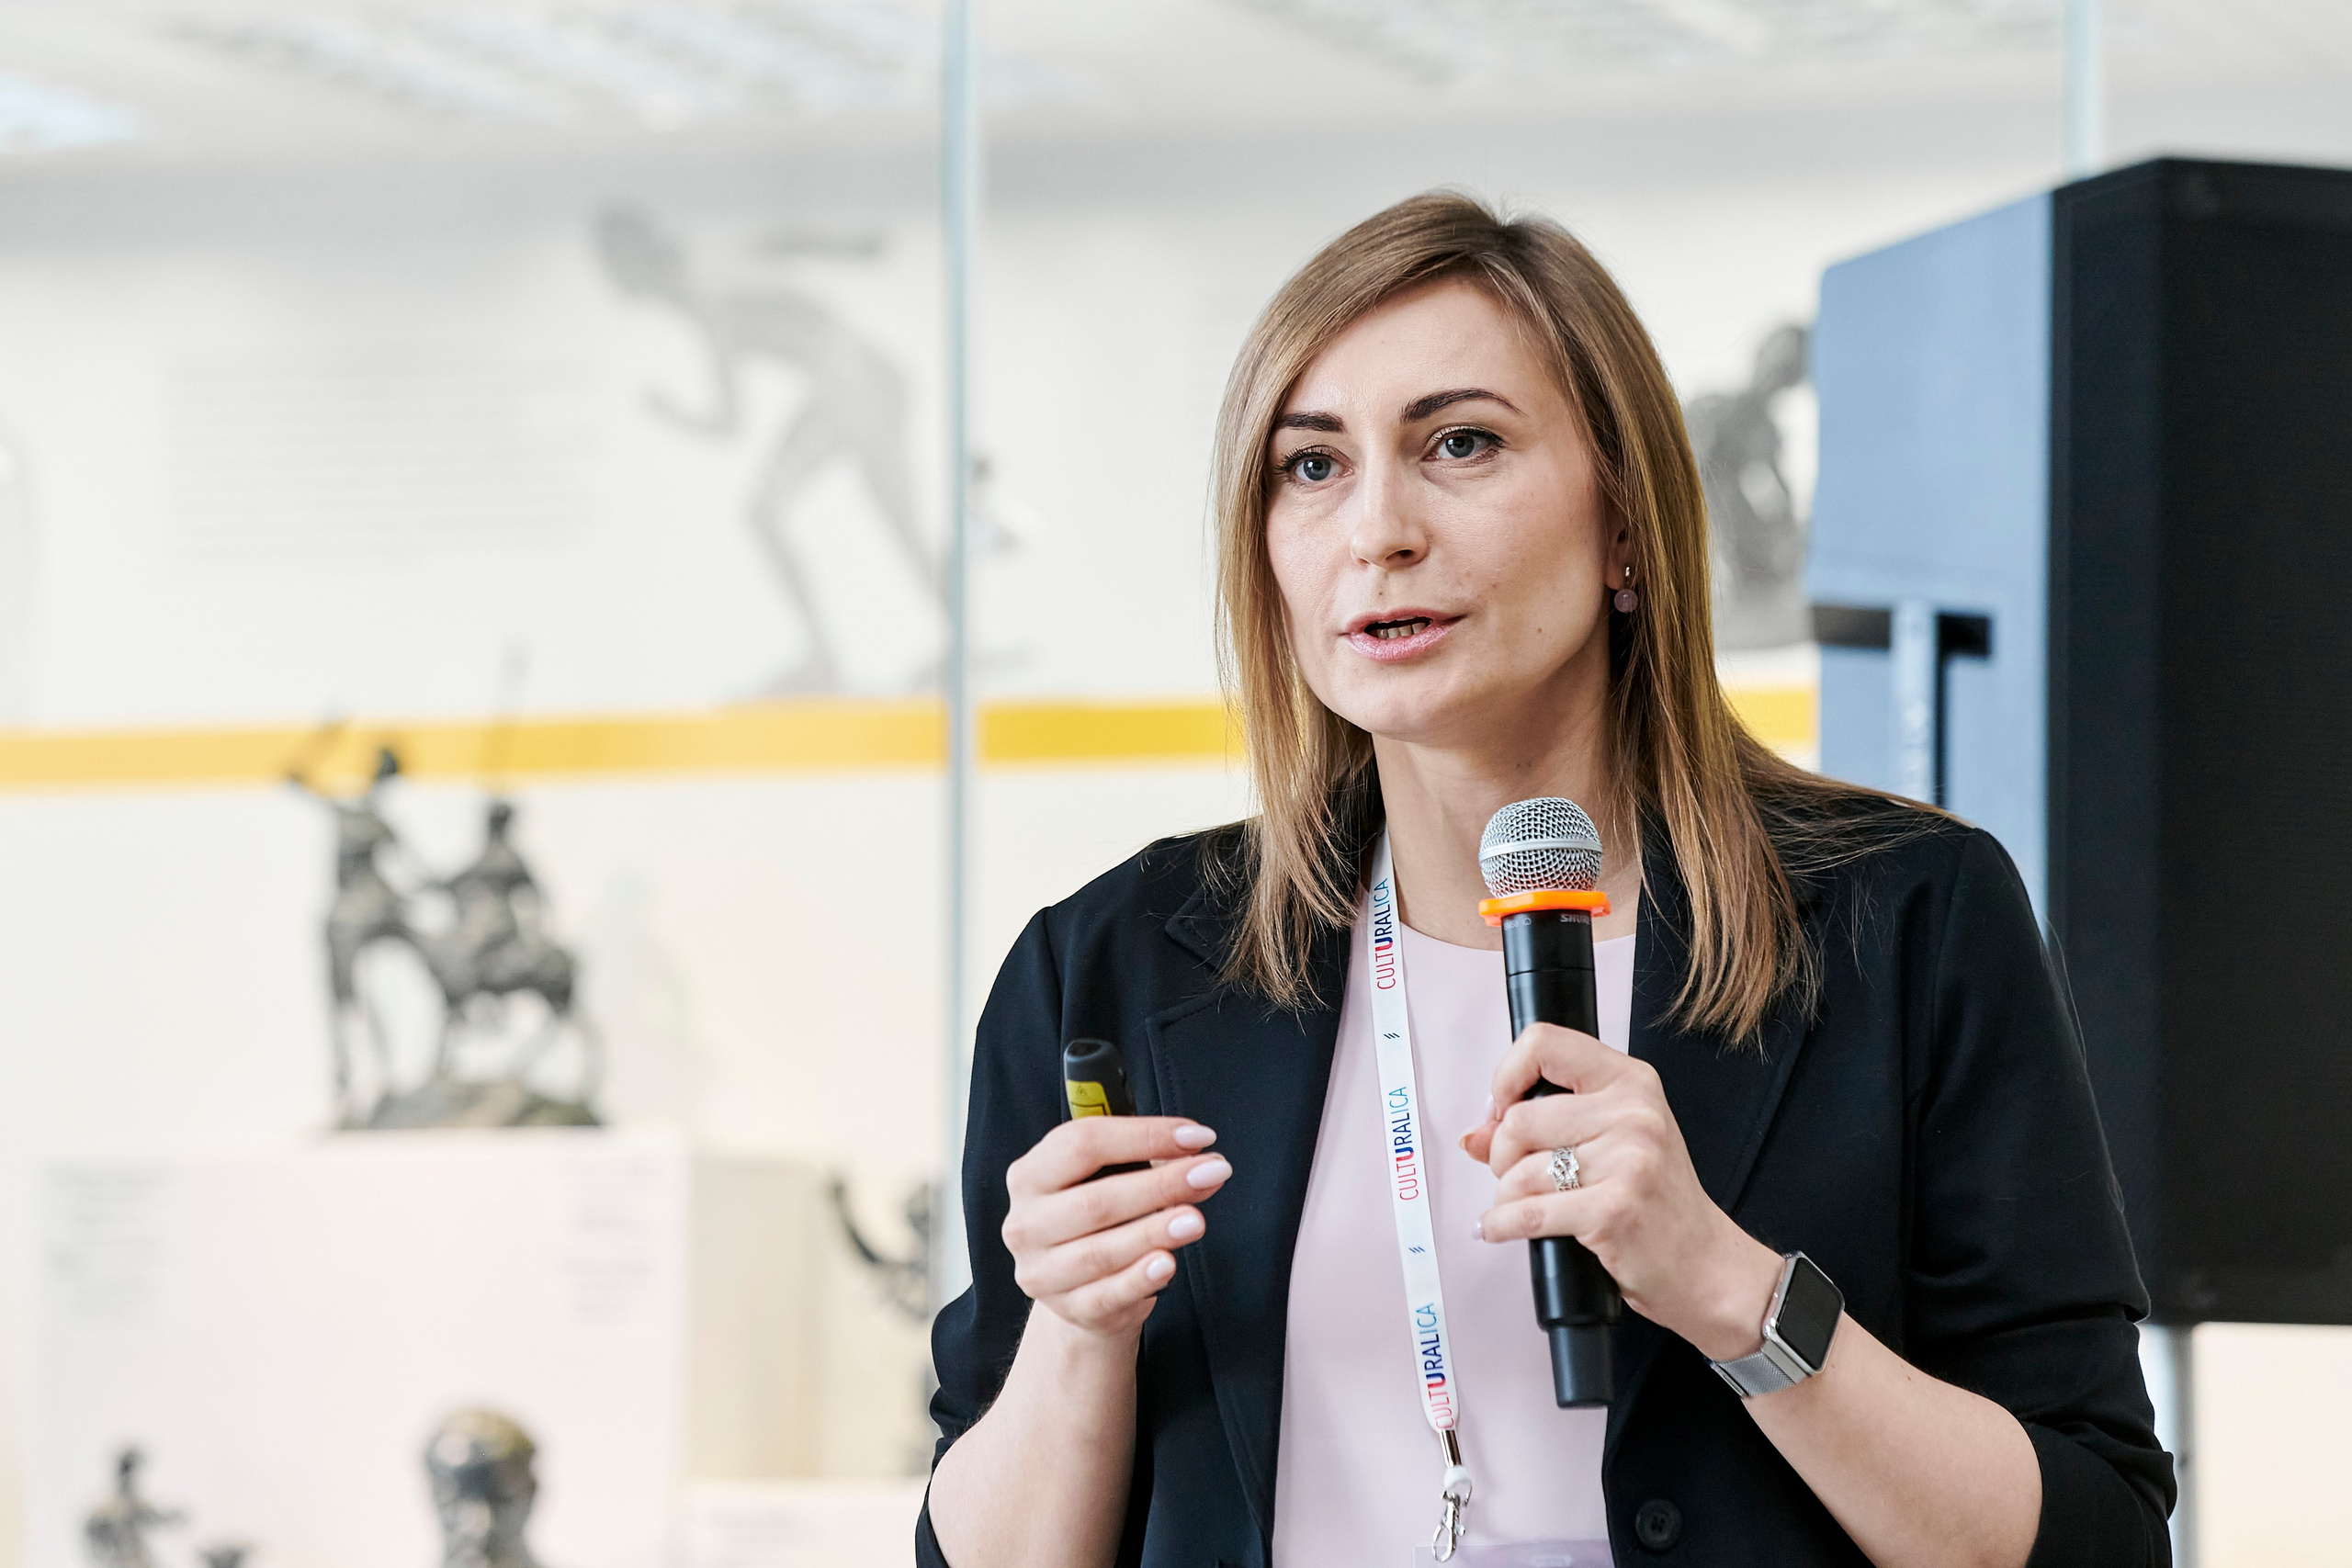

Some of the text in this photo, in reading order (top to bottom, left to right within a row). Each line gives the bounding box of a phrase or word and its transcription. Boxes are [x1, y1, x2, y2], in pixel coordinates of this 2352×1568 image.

[1374, 877, 1396, 990] CULTURALICA
[1560, 913, 1590, 925] SHUR
[1388, 1086, 1419, 1201] CULTURALICA
[1416, 1303, 1454, 1429] CULTURALICA
